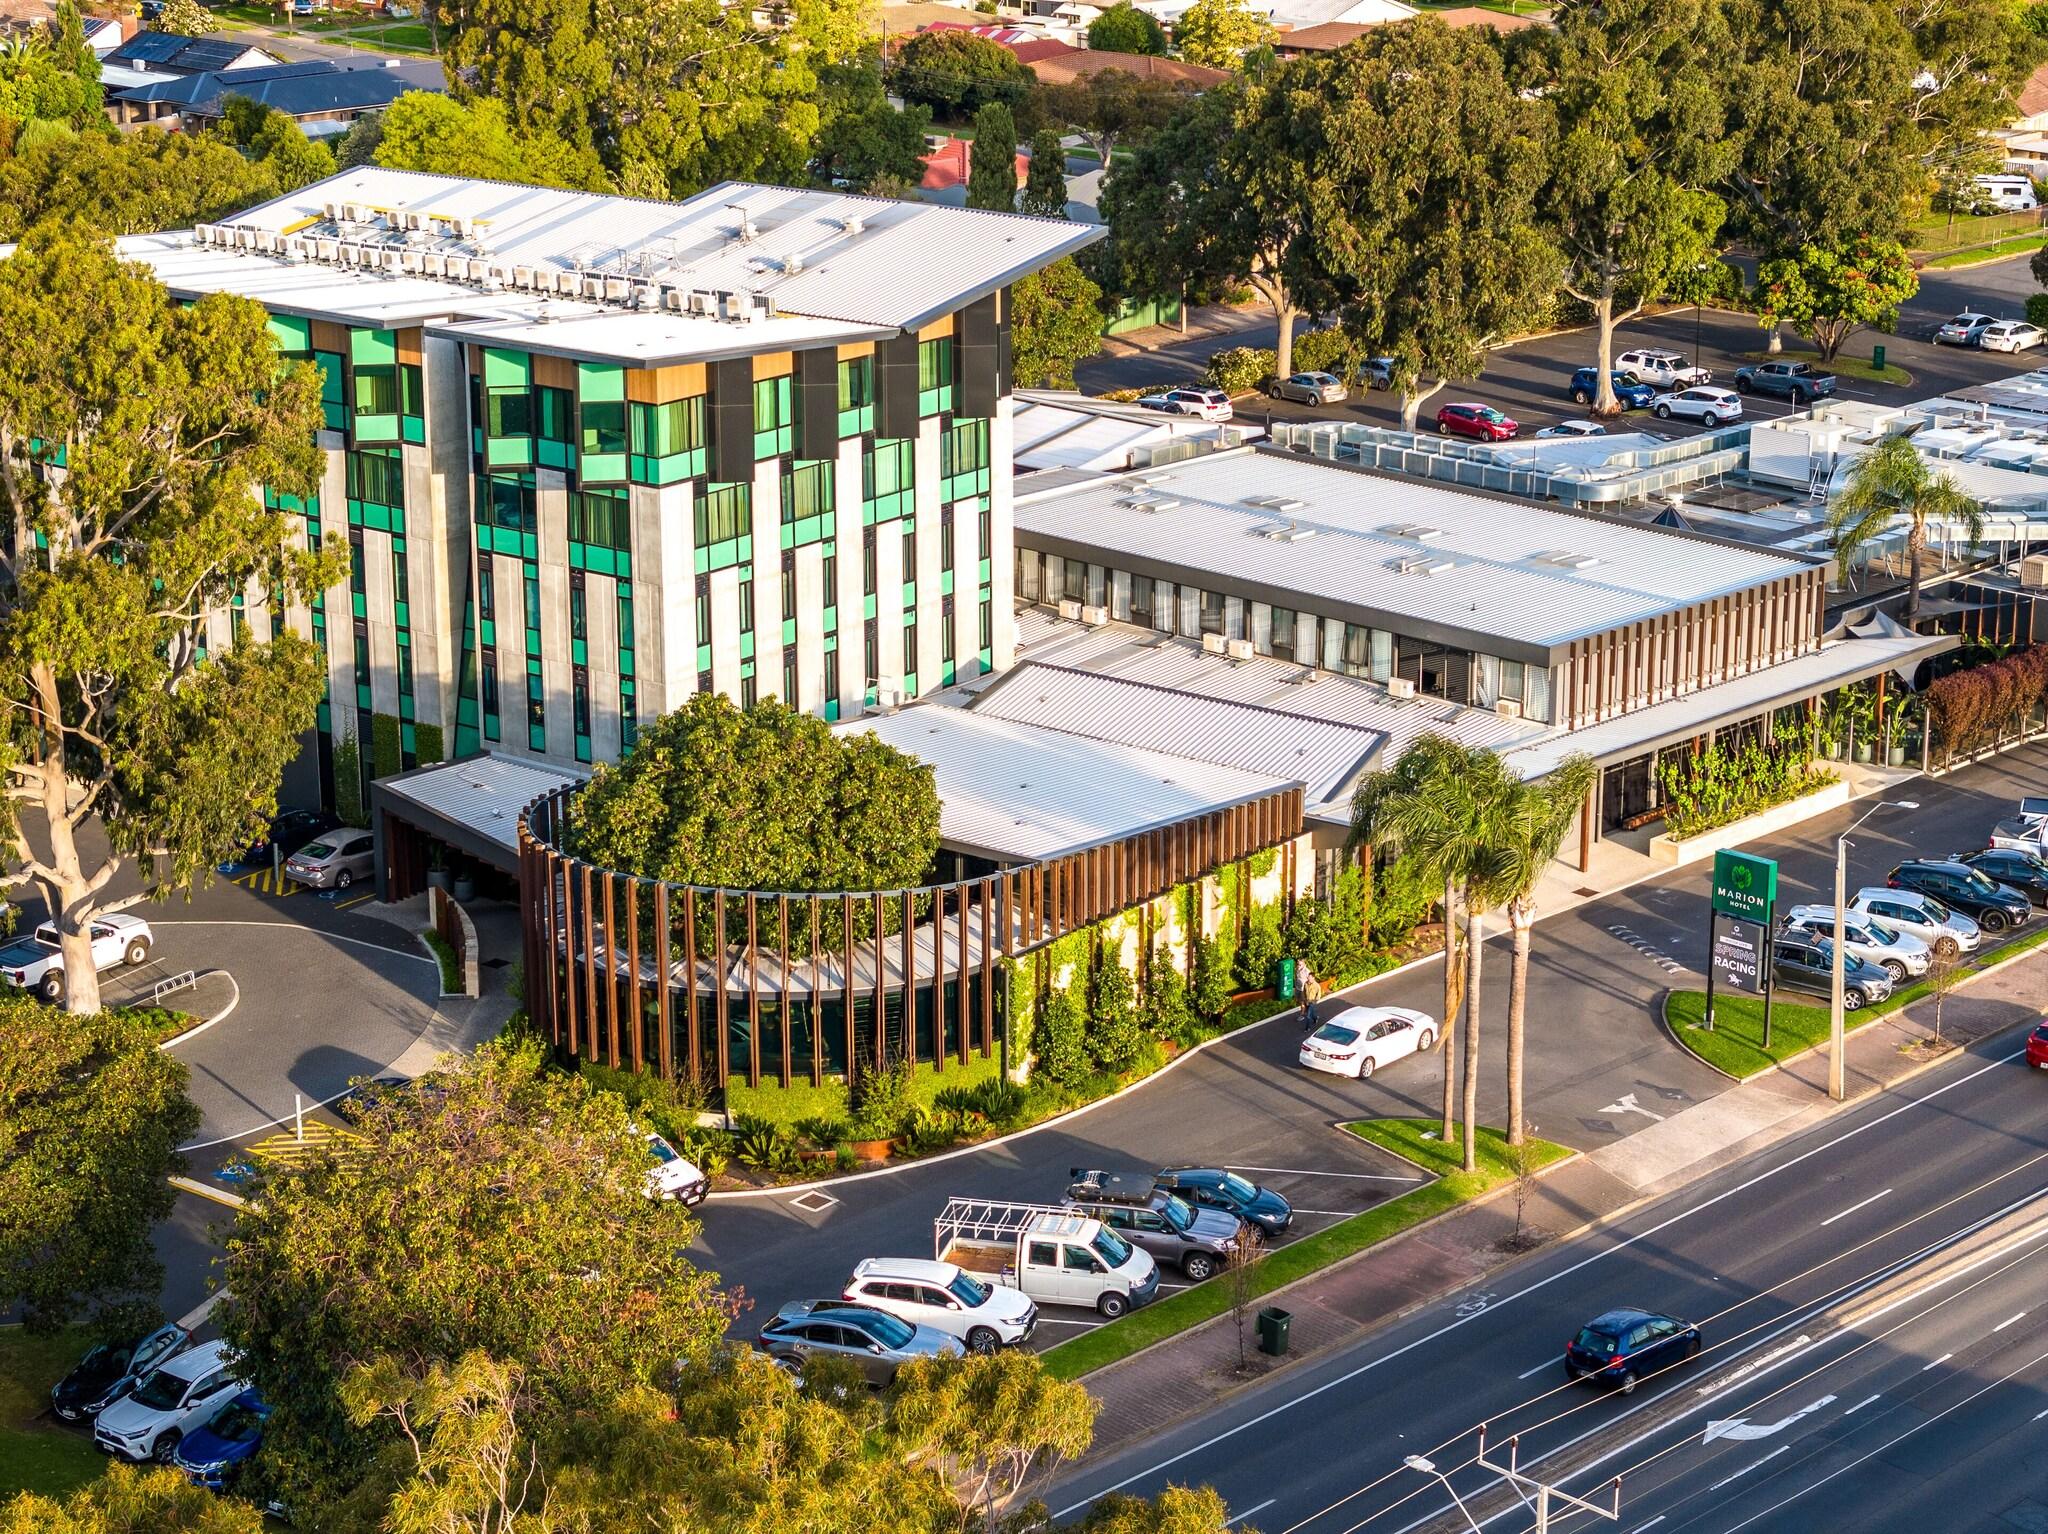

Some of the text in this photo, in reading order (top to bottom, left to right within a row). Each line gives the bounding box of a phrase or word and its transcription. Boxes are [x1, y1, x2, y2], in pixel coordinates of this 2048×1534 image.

[1718, 887, 1764, 907] MARION
[1729, 900, 1751, 911] HOTEL
[1714, 943, 1757, 963] SPRING
[1714, 956, 1756, 976] RACING
